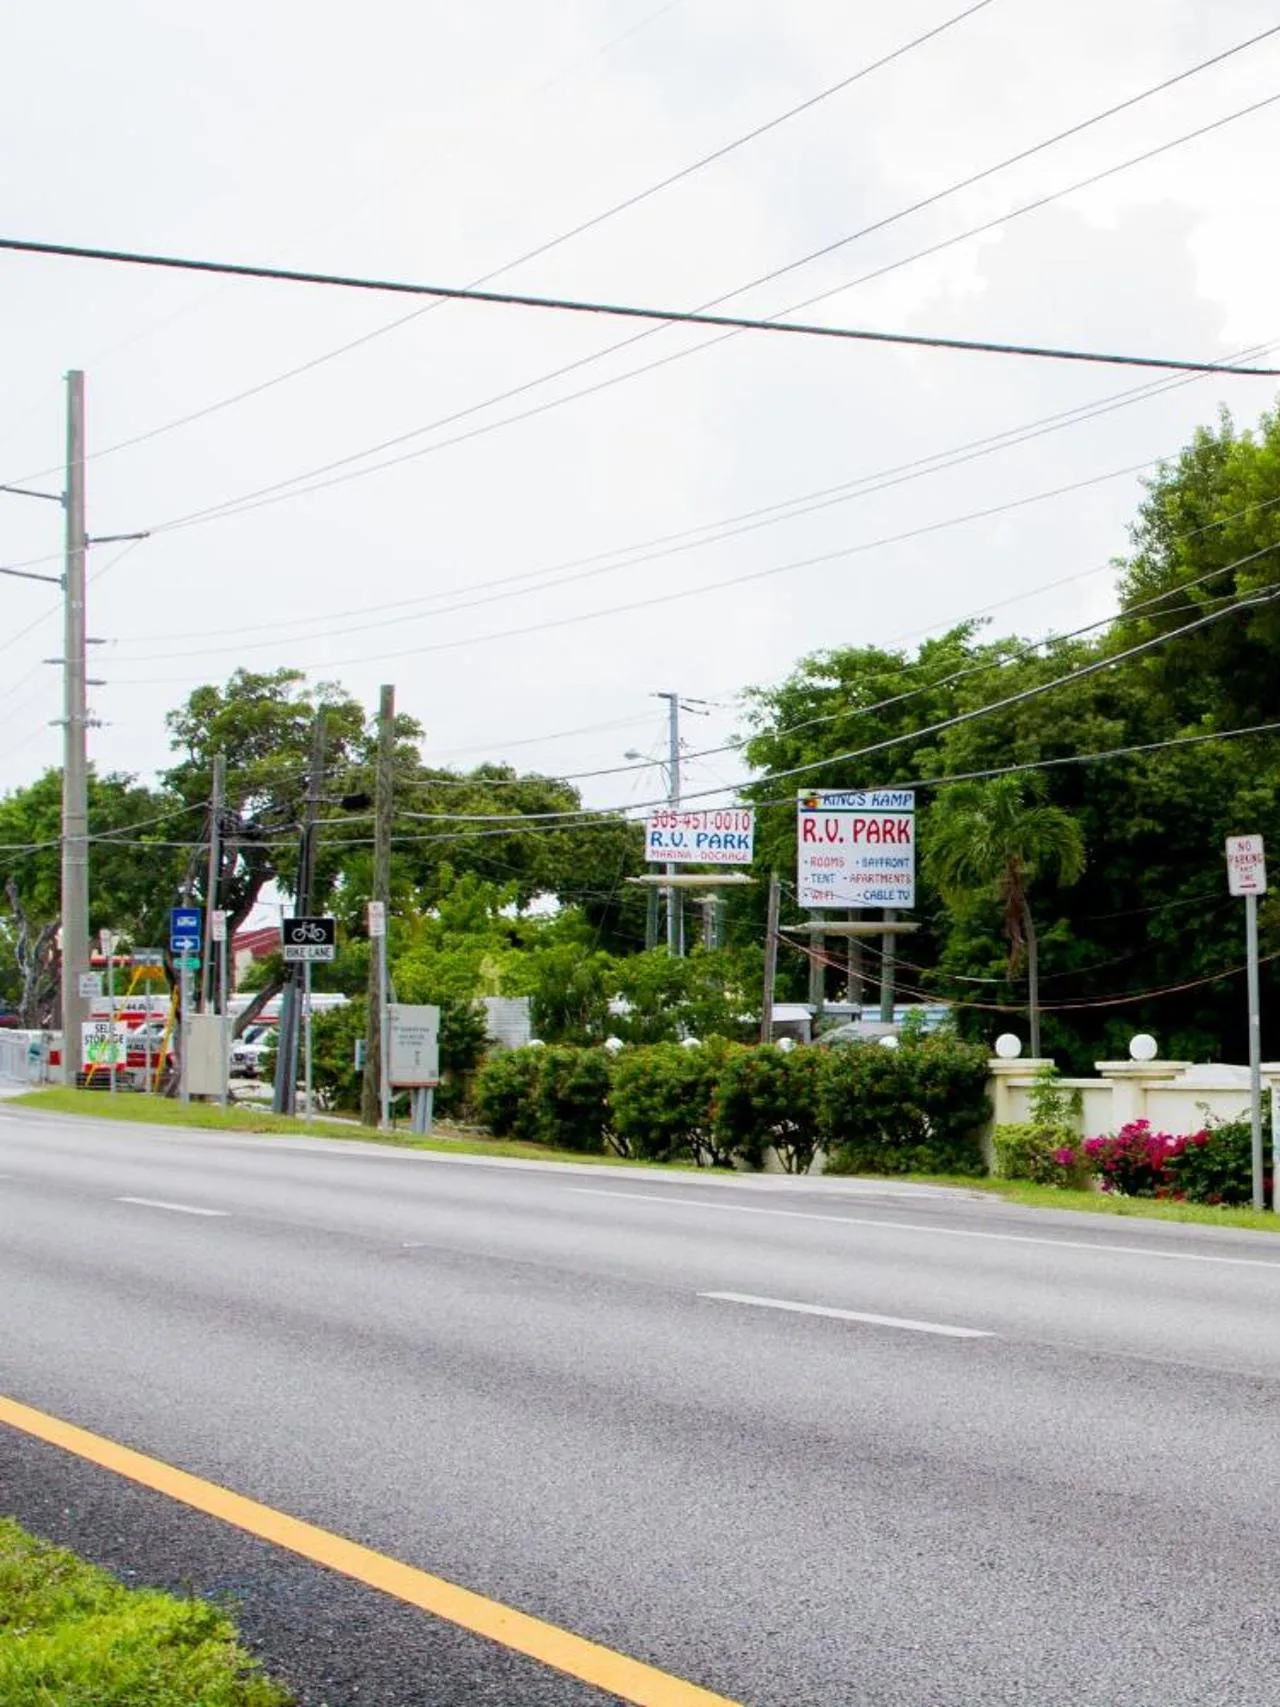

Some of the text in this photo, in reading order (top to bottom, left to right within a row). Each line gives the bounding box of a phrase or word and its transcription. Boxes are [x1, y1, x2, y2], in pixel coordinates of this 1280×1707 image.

[872, 793, 912, 807] KAMP
[803, 818, 911, 844] R.V. PARK
[651, 831, 750, 850] R.V. PARK
[1237, 840, 1252, 851] NO
[810, 856, 845, 868] ROOMS
[1228, 853, 1264, 864] PARKING
[811, 873, 911, 884] TENT APARTMENTS
[863, 890, 895, 900] CABLE
[896, 890, 910, 900] TV
[286, 946, 332, 959] BIKE LANE
